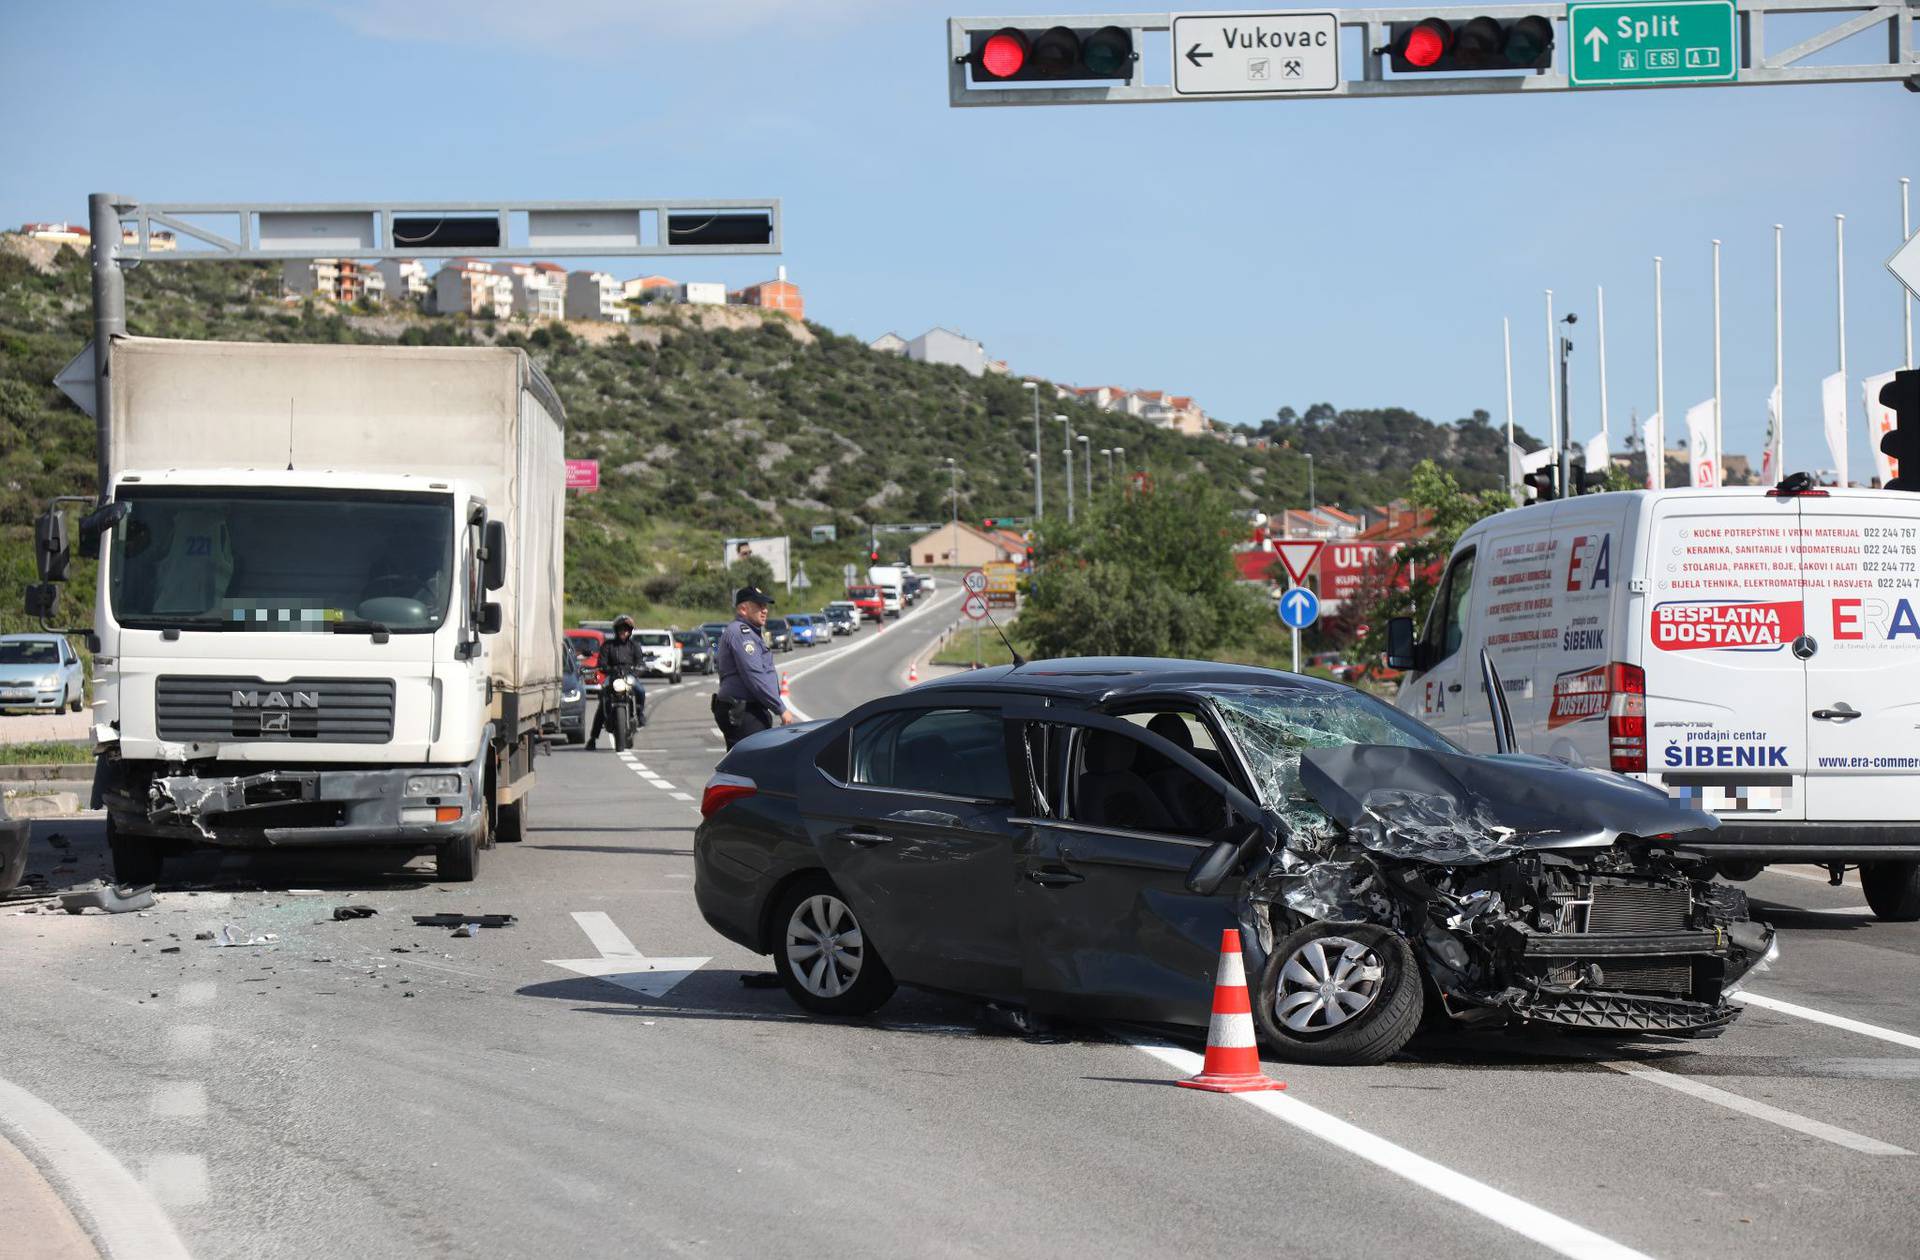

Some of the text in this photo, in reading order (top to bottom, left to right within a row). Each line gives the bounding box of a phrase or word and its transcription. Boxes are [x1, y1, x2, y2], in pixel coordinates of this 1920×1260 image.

[1222, 26, 1328, 48] Vukovac
[1617, 15, 1680, 43] Split
[1650, 52, 1657, 65] E
[1661, 52, 1675, 65] 65
[1692, 51, 1700, 64] A
[1815, 528, 1860, 537] MATERIJAL
[1864, 527, 1880, 537] 022
[1882, 527, 1898, 537] 244
[1686, 546, 1733, 555] KERAMIKA,
[1735, 545, 1782, 554] SANITARIJE
[1791, 545, 1861, 554] VODOMATERIJALI
[1863, 545, 1880, 554] 022
[1882, 545, 1898, 554] 244
[1901, 545, 1917, 555] 765
[1683, 562, 1731, 572] STOLARIJA,
[1733, 562, 1770, 571] PARKETI,
[1772, 562, 1796, 571] BOJE,
[1799, 562, 1827, 571] LAKOVI
[1835, 562, 1858, 571] ALATI
[1863, 562, 1879, 571] 022
[1881, 562, 1897, 571] 244
[1900, 562, 1915, 572] 772
[1671, 580, 1700, 589] BIJELA
[1703, 579, 1742, 589] TEHNIKA,
[1744, 579, 1825, 588] ELEKTROMATERIJAL
[1833, 579, 1873, 588] RASVJETA
[1878, 578, 1894, 588] 022
[1896, 578, 1912, 588] 244
[1660, 607, 1780, 624] BESPLATNA
[1832, 598, 1920, 640] ERA
[1660, 623, 1780, 644] DOSTAVA!
[232, 691, 319, 708] MAN
[1687, 730, 1767, 742] prodajni centar
[1664, 740, 1789, 767] ŠIBENIK
